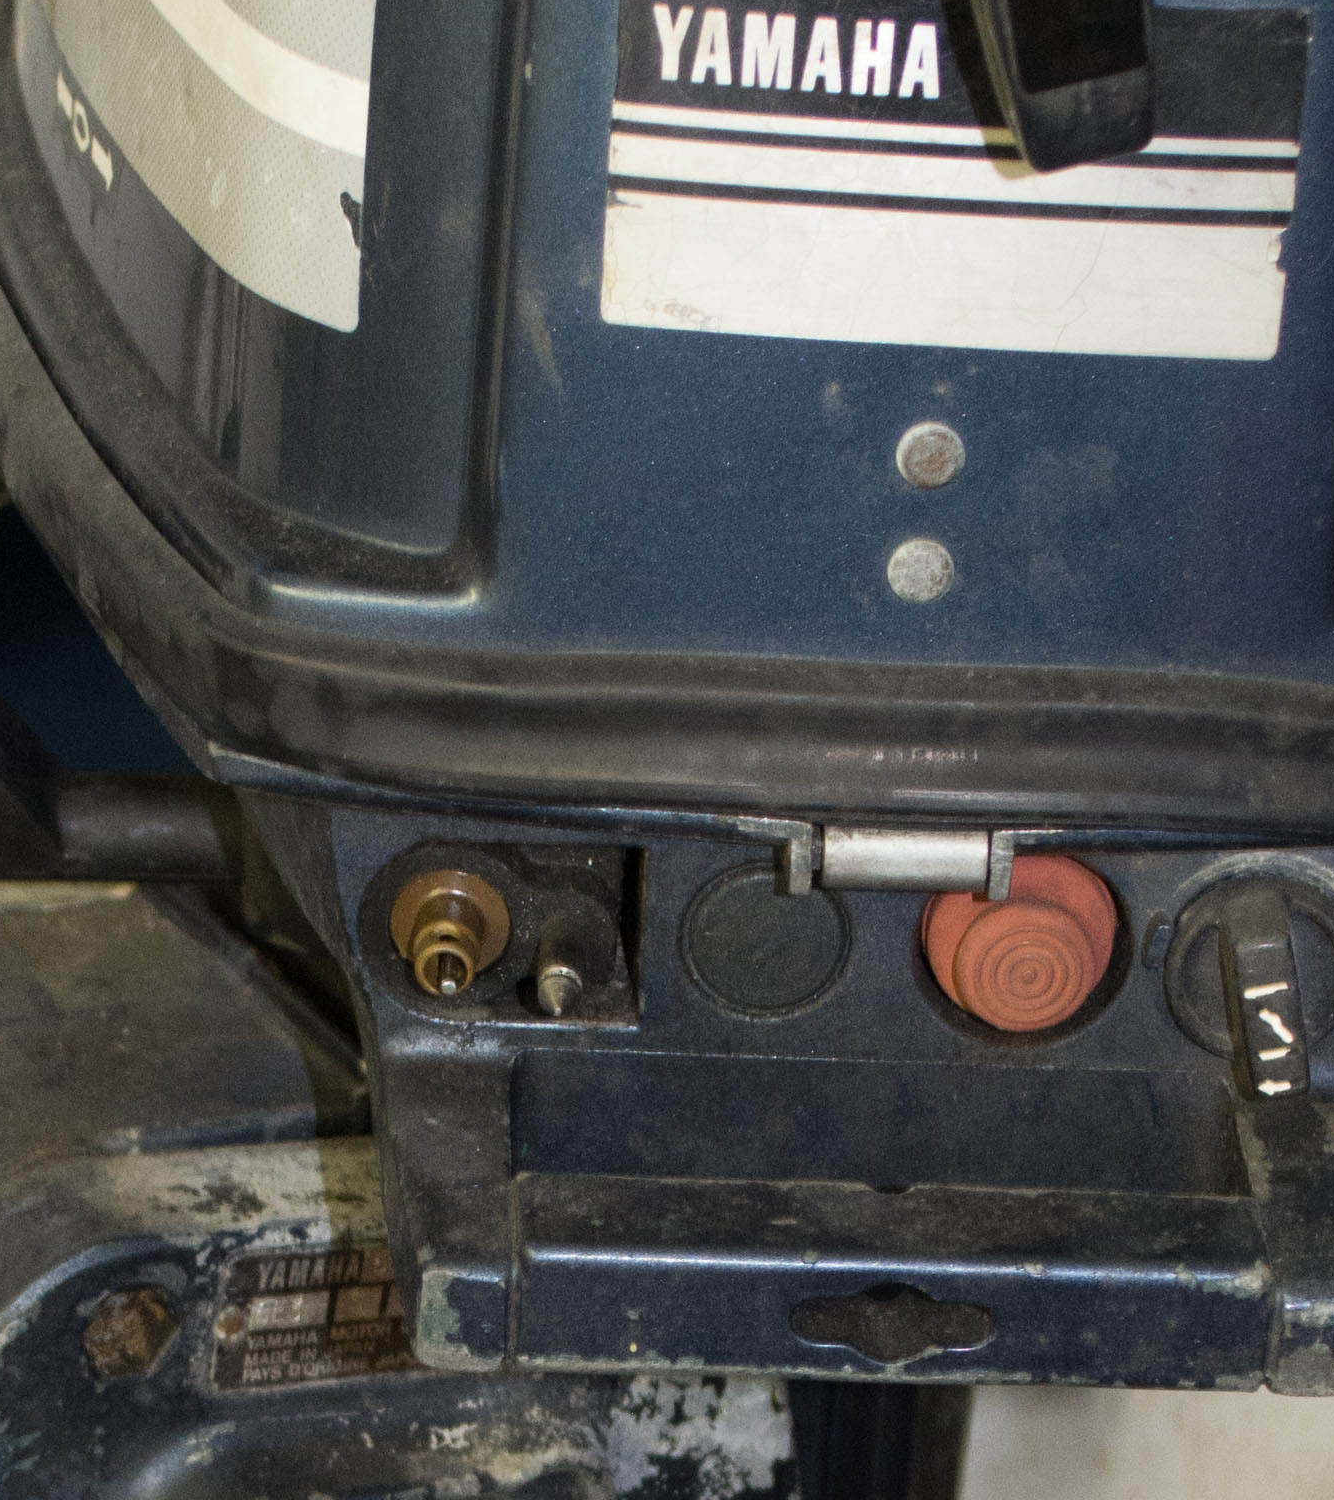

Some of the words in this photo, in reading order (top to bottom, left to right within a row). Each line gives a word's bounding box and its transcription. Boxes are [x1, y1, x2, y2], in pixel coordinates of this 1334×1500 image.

[653, 3, 942, 100] YAMAHA
[258, 1255, 360, 1290] YAMAHA
[248, 1332, 319, 1350] YAMAHA
[243, 1349, 293, 1367] MADE
[300, 1346, 318, 1361] IN
[241, 1364, 283, 1383] PAYS
